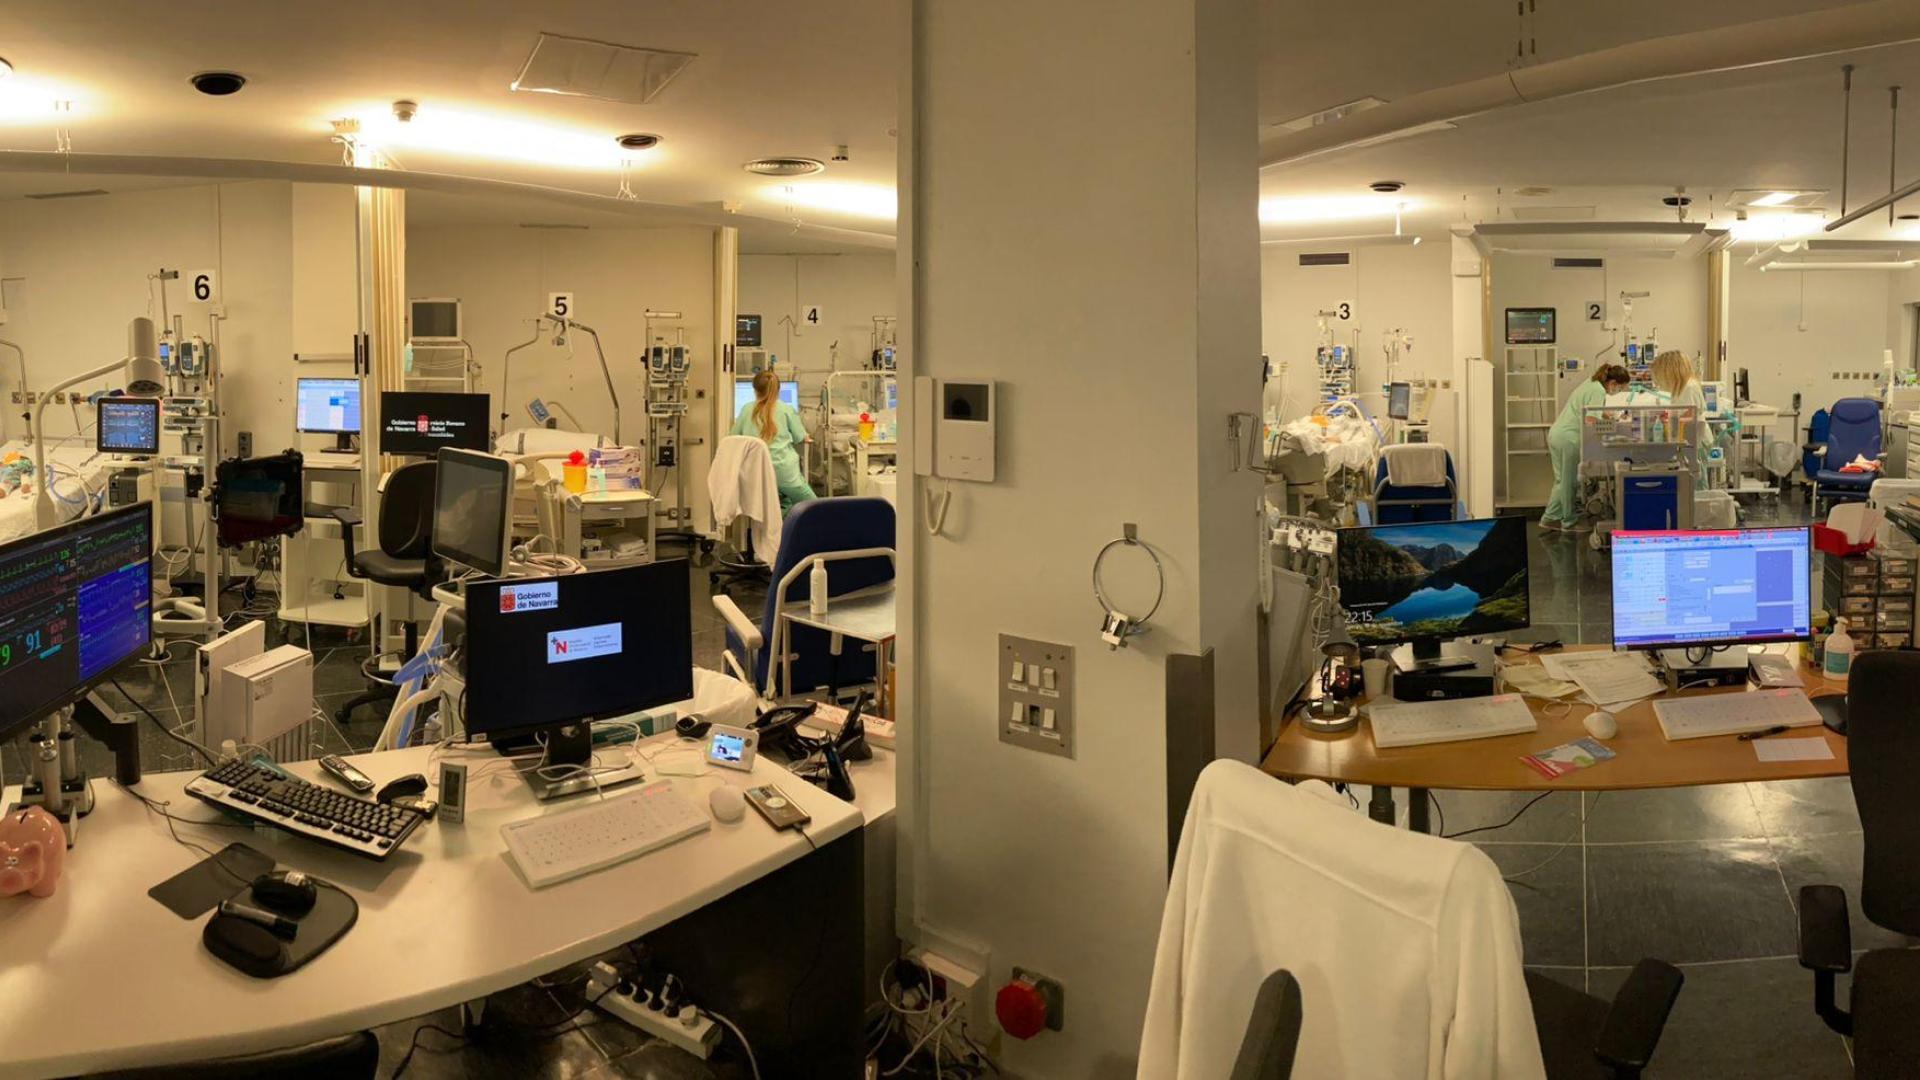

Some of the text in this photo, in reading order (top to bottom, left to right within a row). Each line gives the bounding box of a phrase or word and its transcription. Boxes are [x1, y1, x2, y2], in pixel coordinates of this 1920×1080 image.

[195, 274, 209, 300] 6
[555, 296, 567, 315] 5
[1340, 303, 1350, 320] 3
[1590, 304, 1600, 320] 2
[807, 308, 818, 324] 4
[517, 591, 552, 600] Gobierno
[528, 600, 559, 608] Navarra
[26, 630, 42, 654] 91
[556, 641, 567, 655] N
